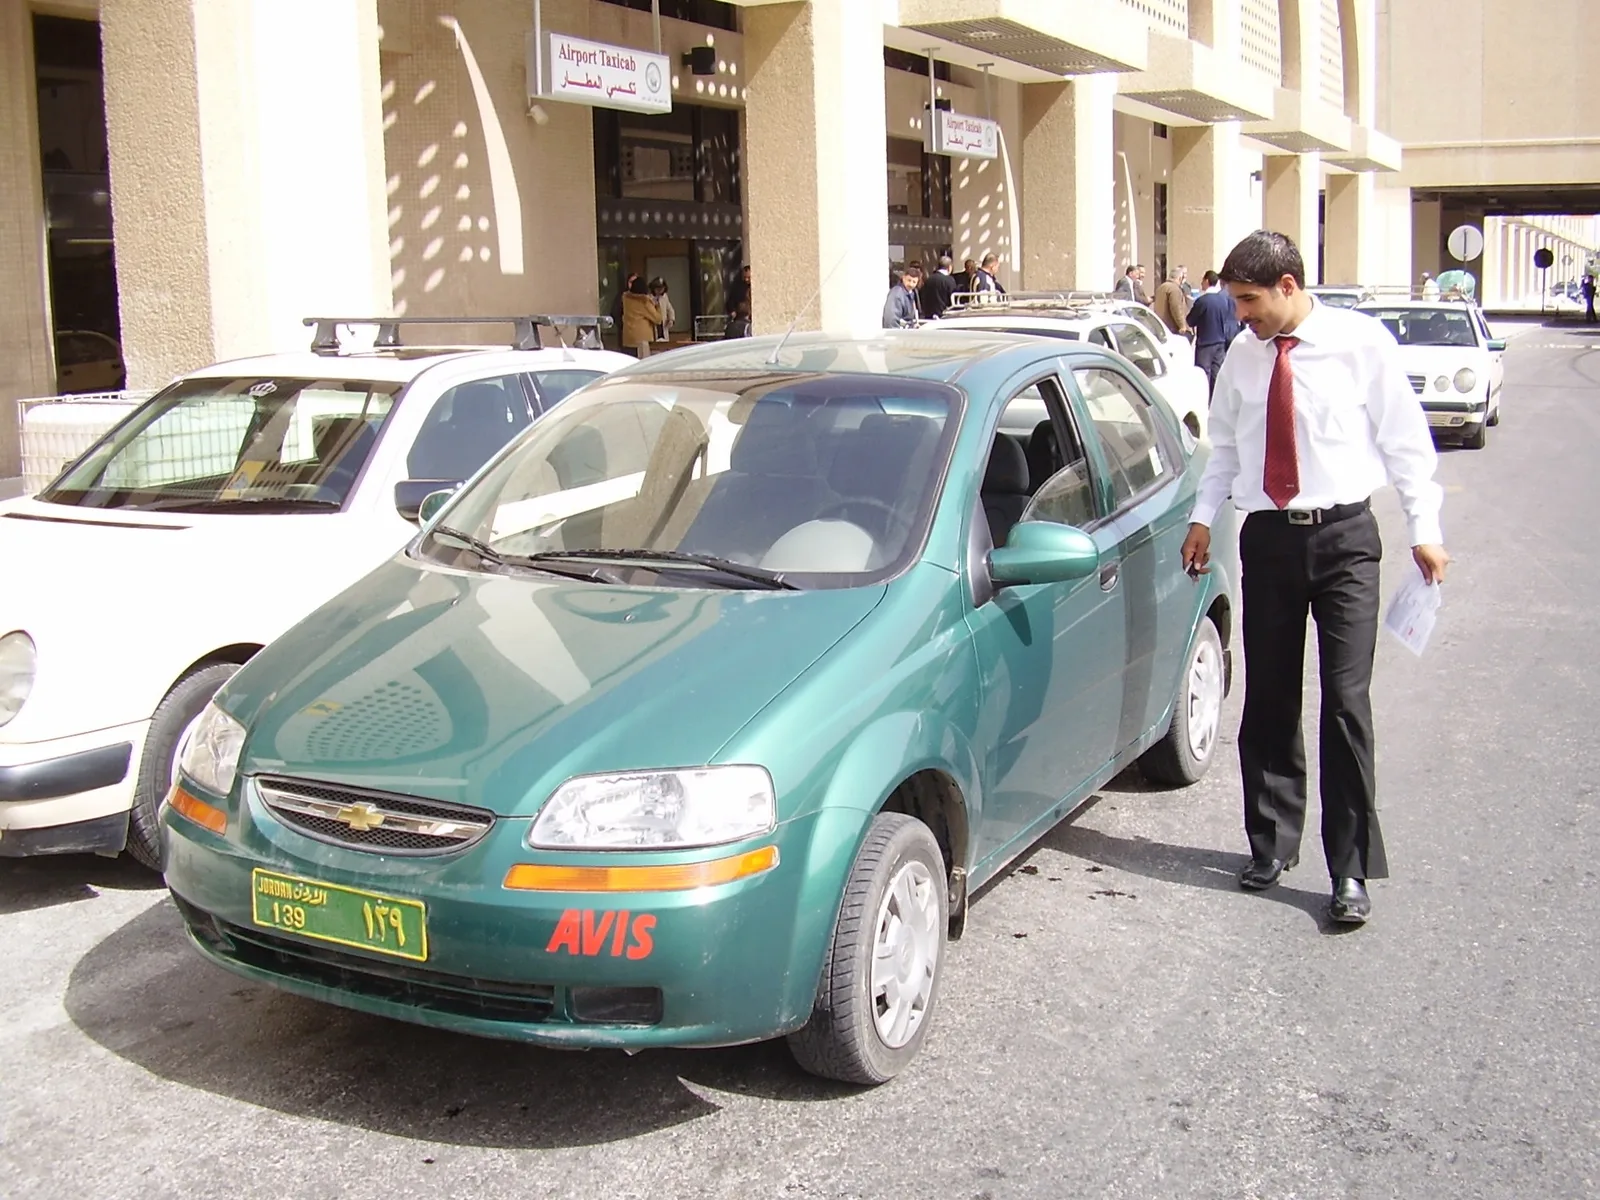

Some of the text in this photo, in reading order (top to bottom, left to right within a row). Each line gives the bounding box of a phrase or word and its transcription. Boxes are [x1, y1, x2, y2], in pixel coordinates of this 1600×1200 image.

[559, 43, 636, 72] Airport Taxicab
[946, 117, 964, 132] Airport
[258, 877, 293, 900] JORDAN
[273, 902, 306, 929] 139
[544, 907, 658, 961] AVIS
